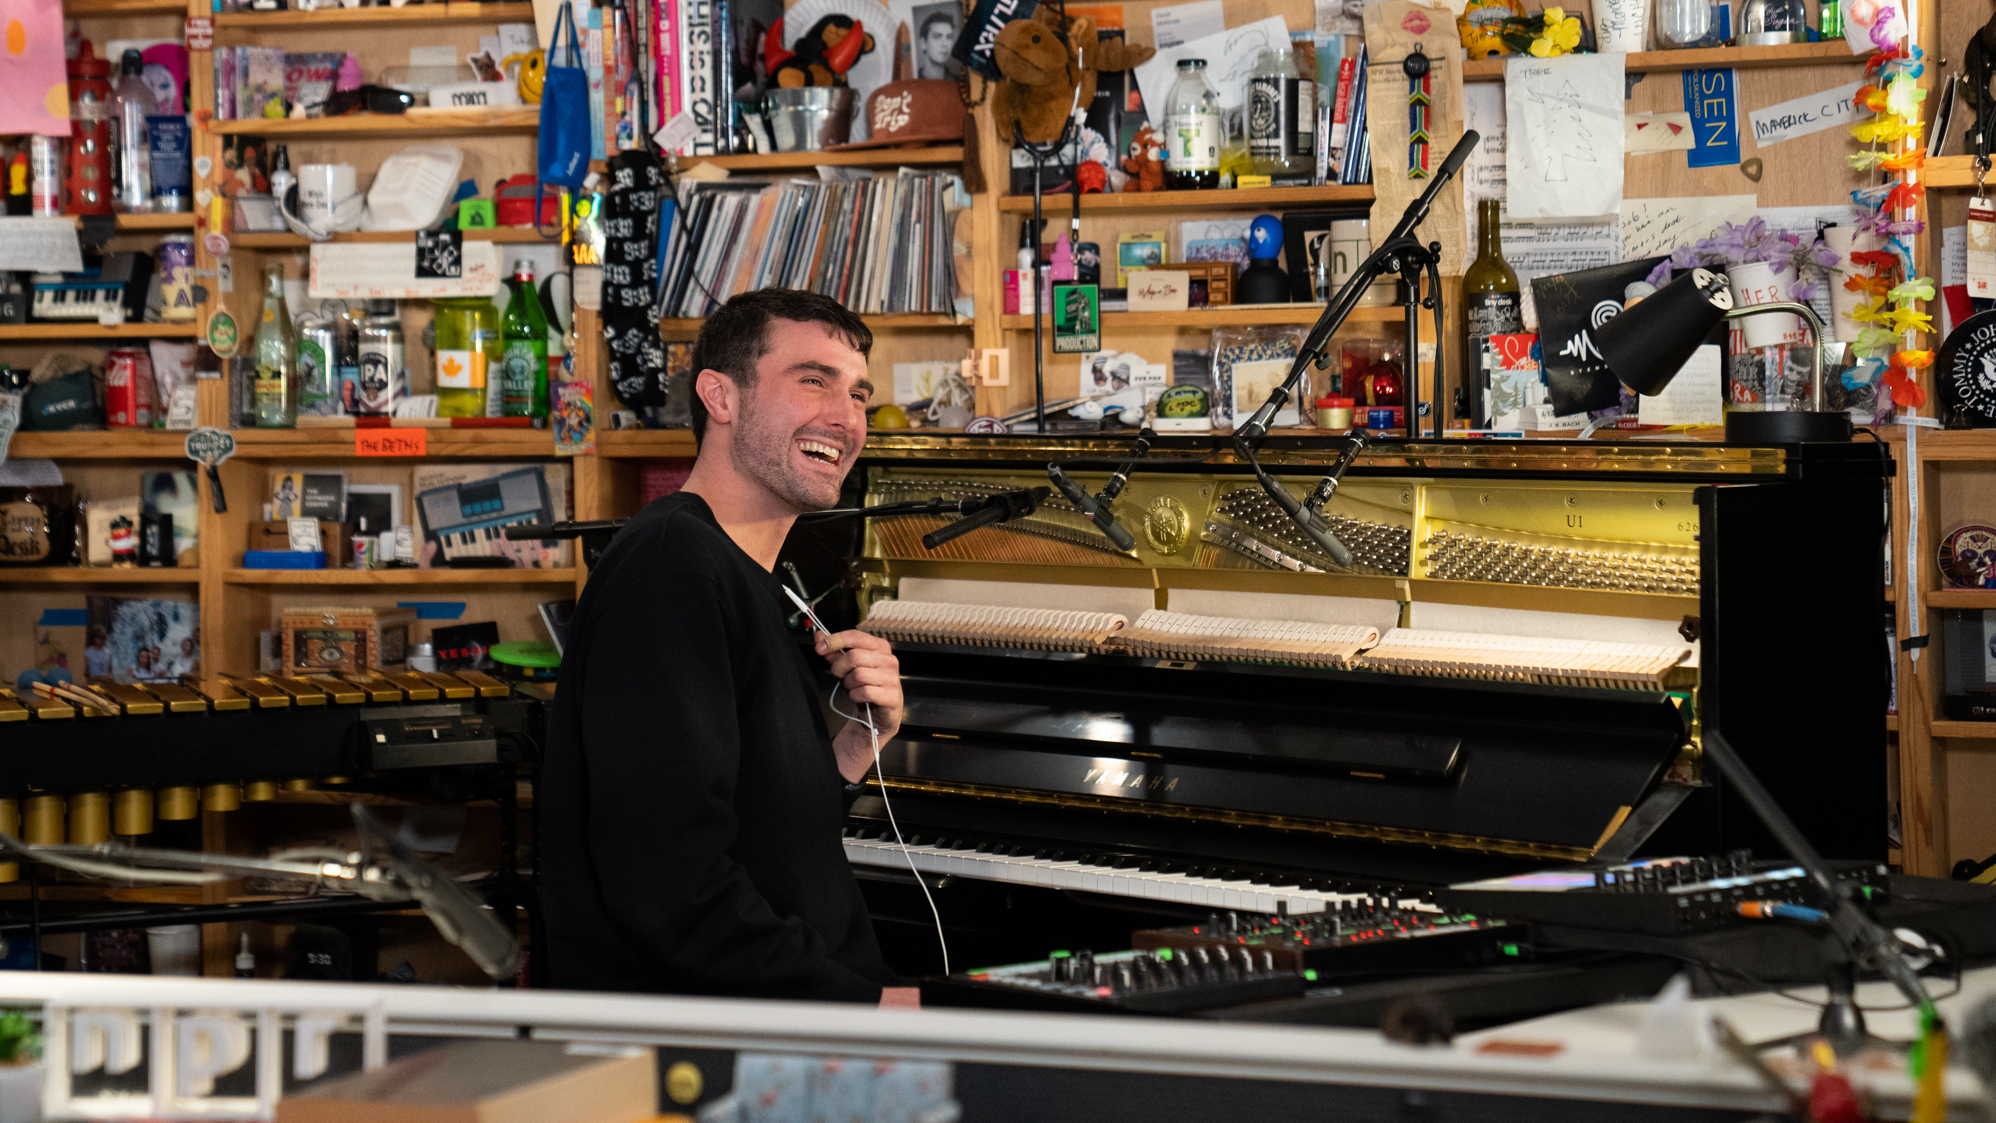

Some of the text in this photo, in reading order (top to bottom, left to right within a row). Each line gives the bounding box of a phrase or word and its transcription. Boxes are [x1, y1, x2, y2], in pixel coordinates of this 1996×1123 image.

[659, 0, 670, 31] OOD
[1519, 67, 1553, 79] TREE
[874, 90, 913, 115] Don't
[873, 110, 910, 132] Trip
[1755, 112, 1819, 139] MAVERICK
[1055, 335, 1098, 350] PRODUCTION
[361, 362, 388, 383] IPA
[1952, 347, 1979, 409] TOMMY
[1566, 515, 1583, 528] U1
[1082, 768, 1180, 792] YAMAHA
